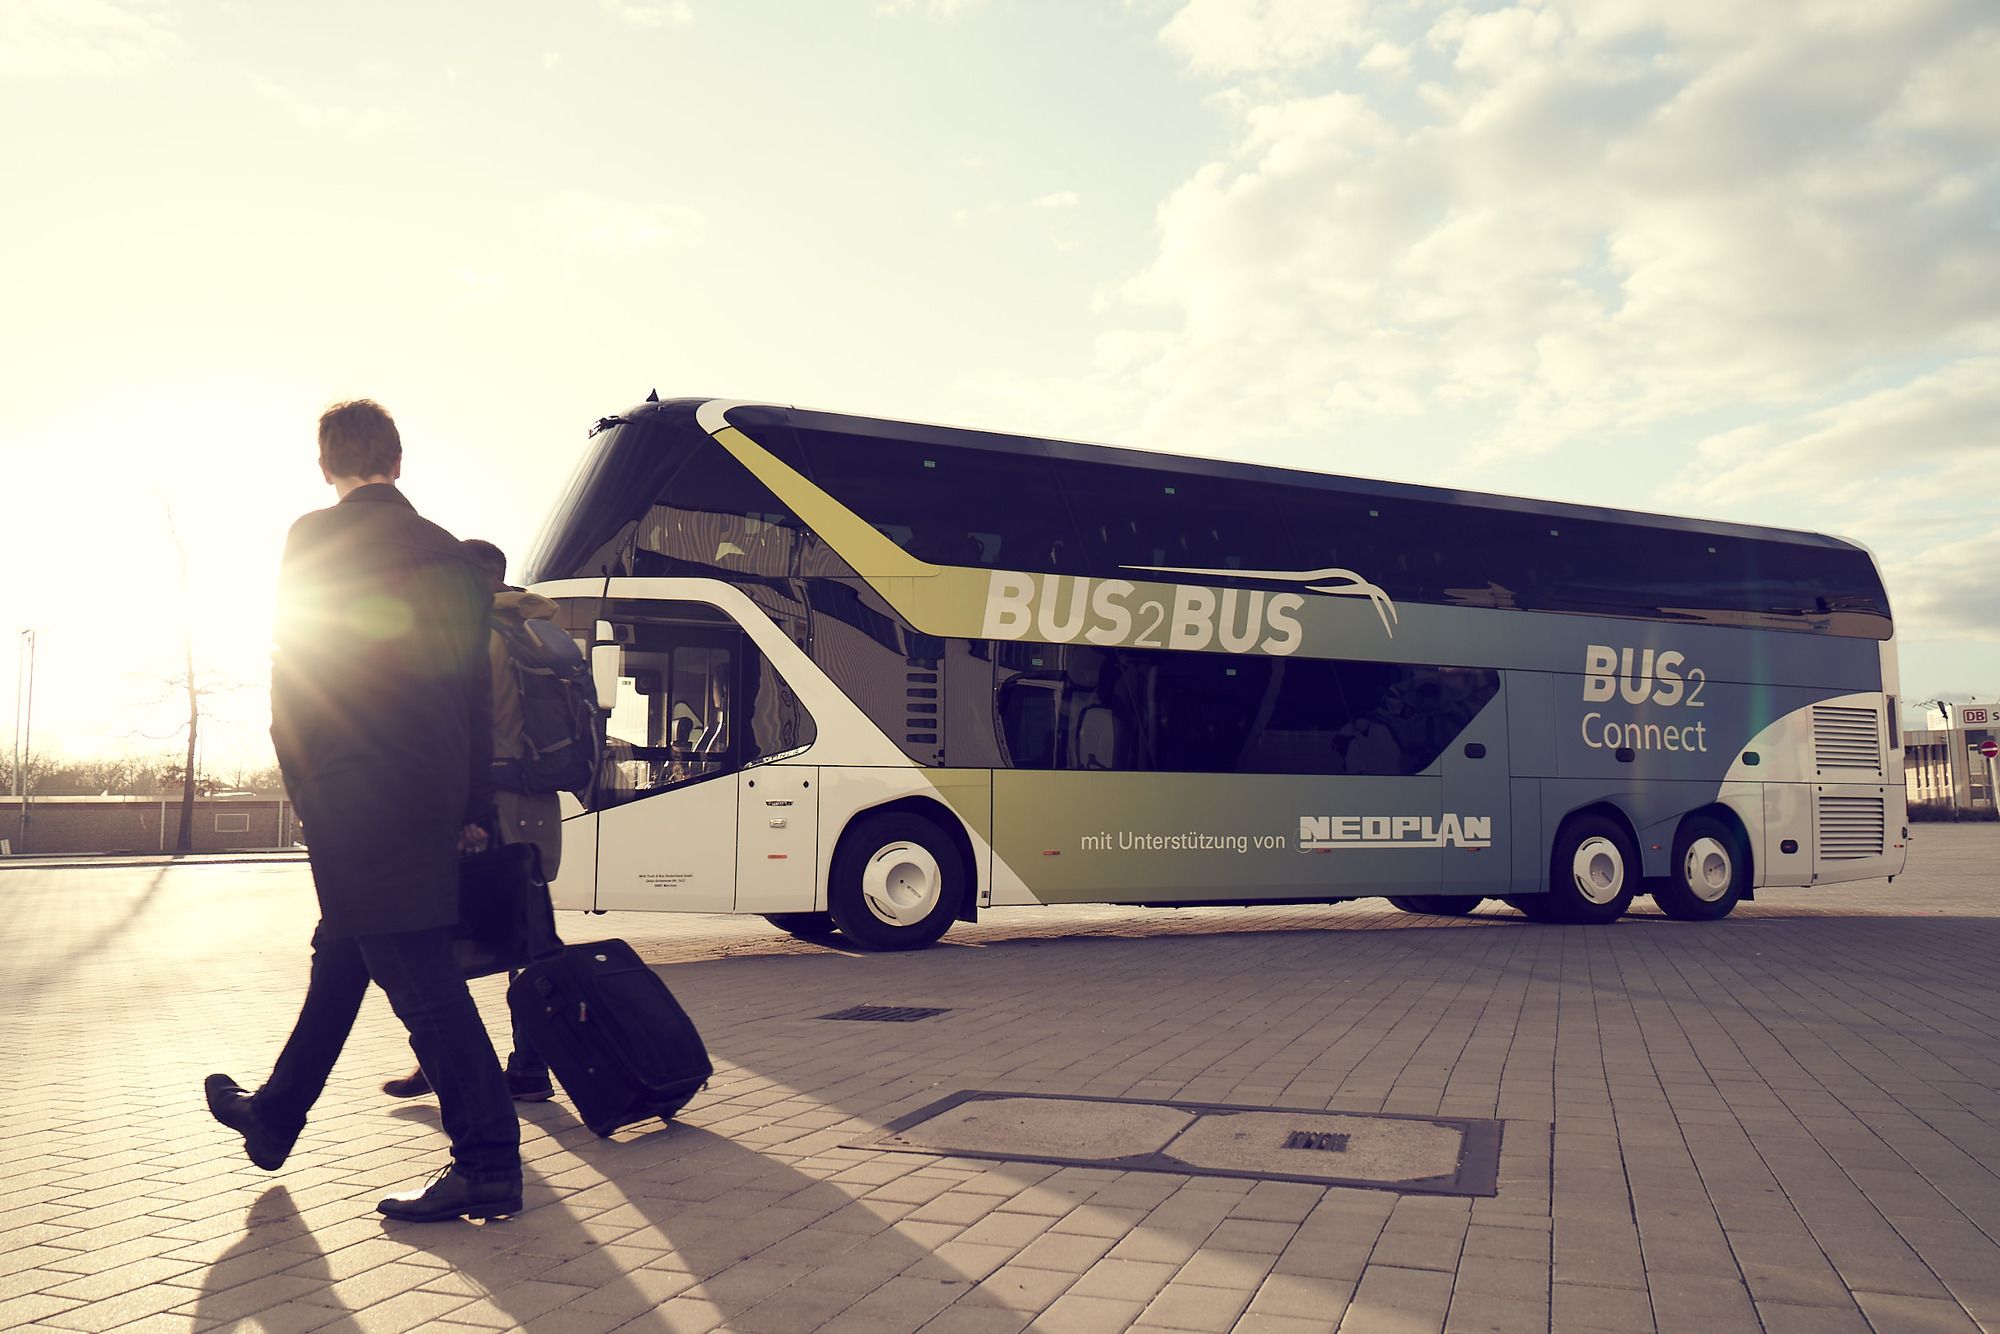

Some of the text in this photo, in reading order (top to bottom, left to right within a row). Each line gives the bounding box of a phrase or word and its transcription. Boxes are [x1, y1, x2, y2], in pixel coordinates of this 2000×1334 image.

[981, 569, 1304, 656] BUS2BUS
[1583, 644, 1706, 707] BUS2
[1581, 712, 1708, 752] Connect
[1966, 711, 1985, 721] DB
[1081, 813, 1491, 854] mit Unterstützung von NEOPLAN
